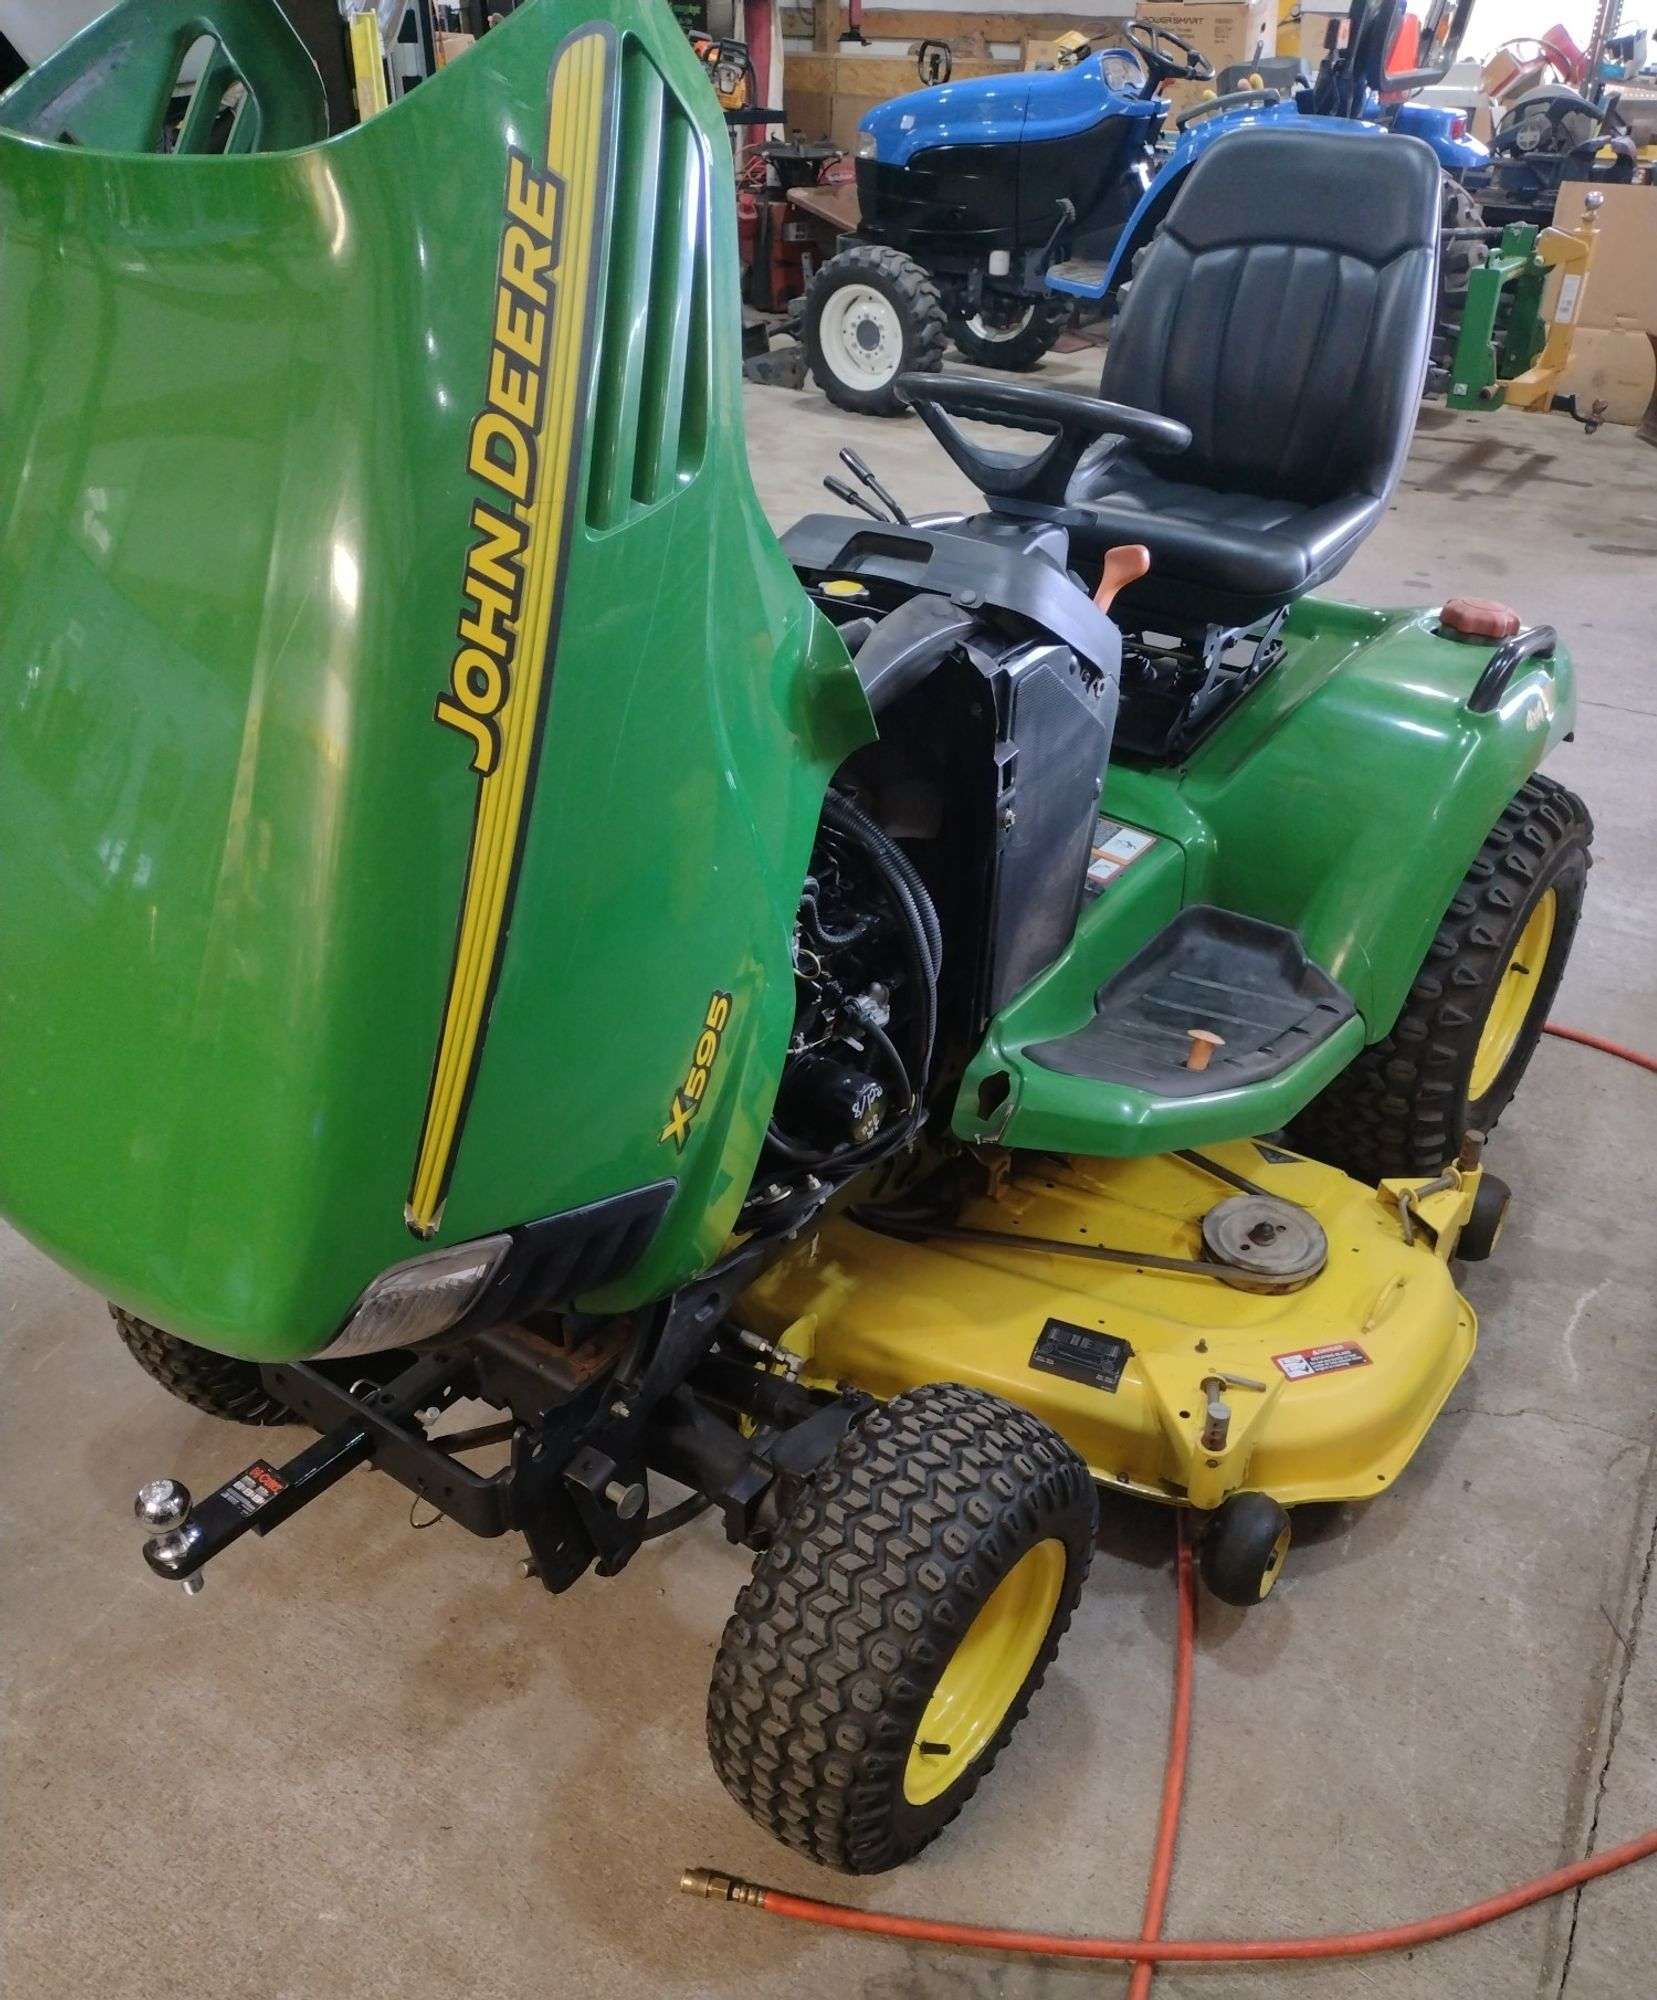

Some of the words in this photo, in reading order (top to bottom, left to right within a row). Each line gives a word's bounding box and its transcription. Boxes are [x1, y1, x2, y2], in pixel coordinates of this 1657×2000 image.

[469, 153, 558, 500] DEERE
[436, 503, 523, 774] JOHN
[659, 991, 731, 1148] X595
